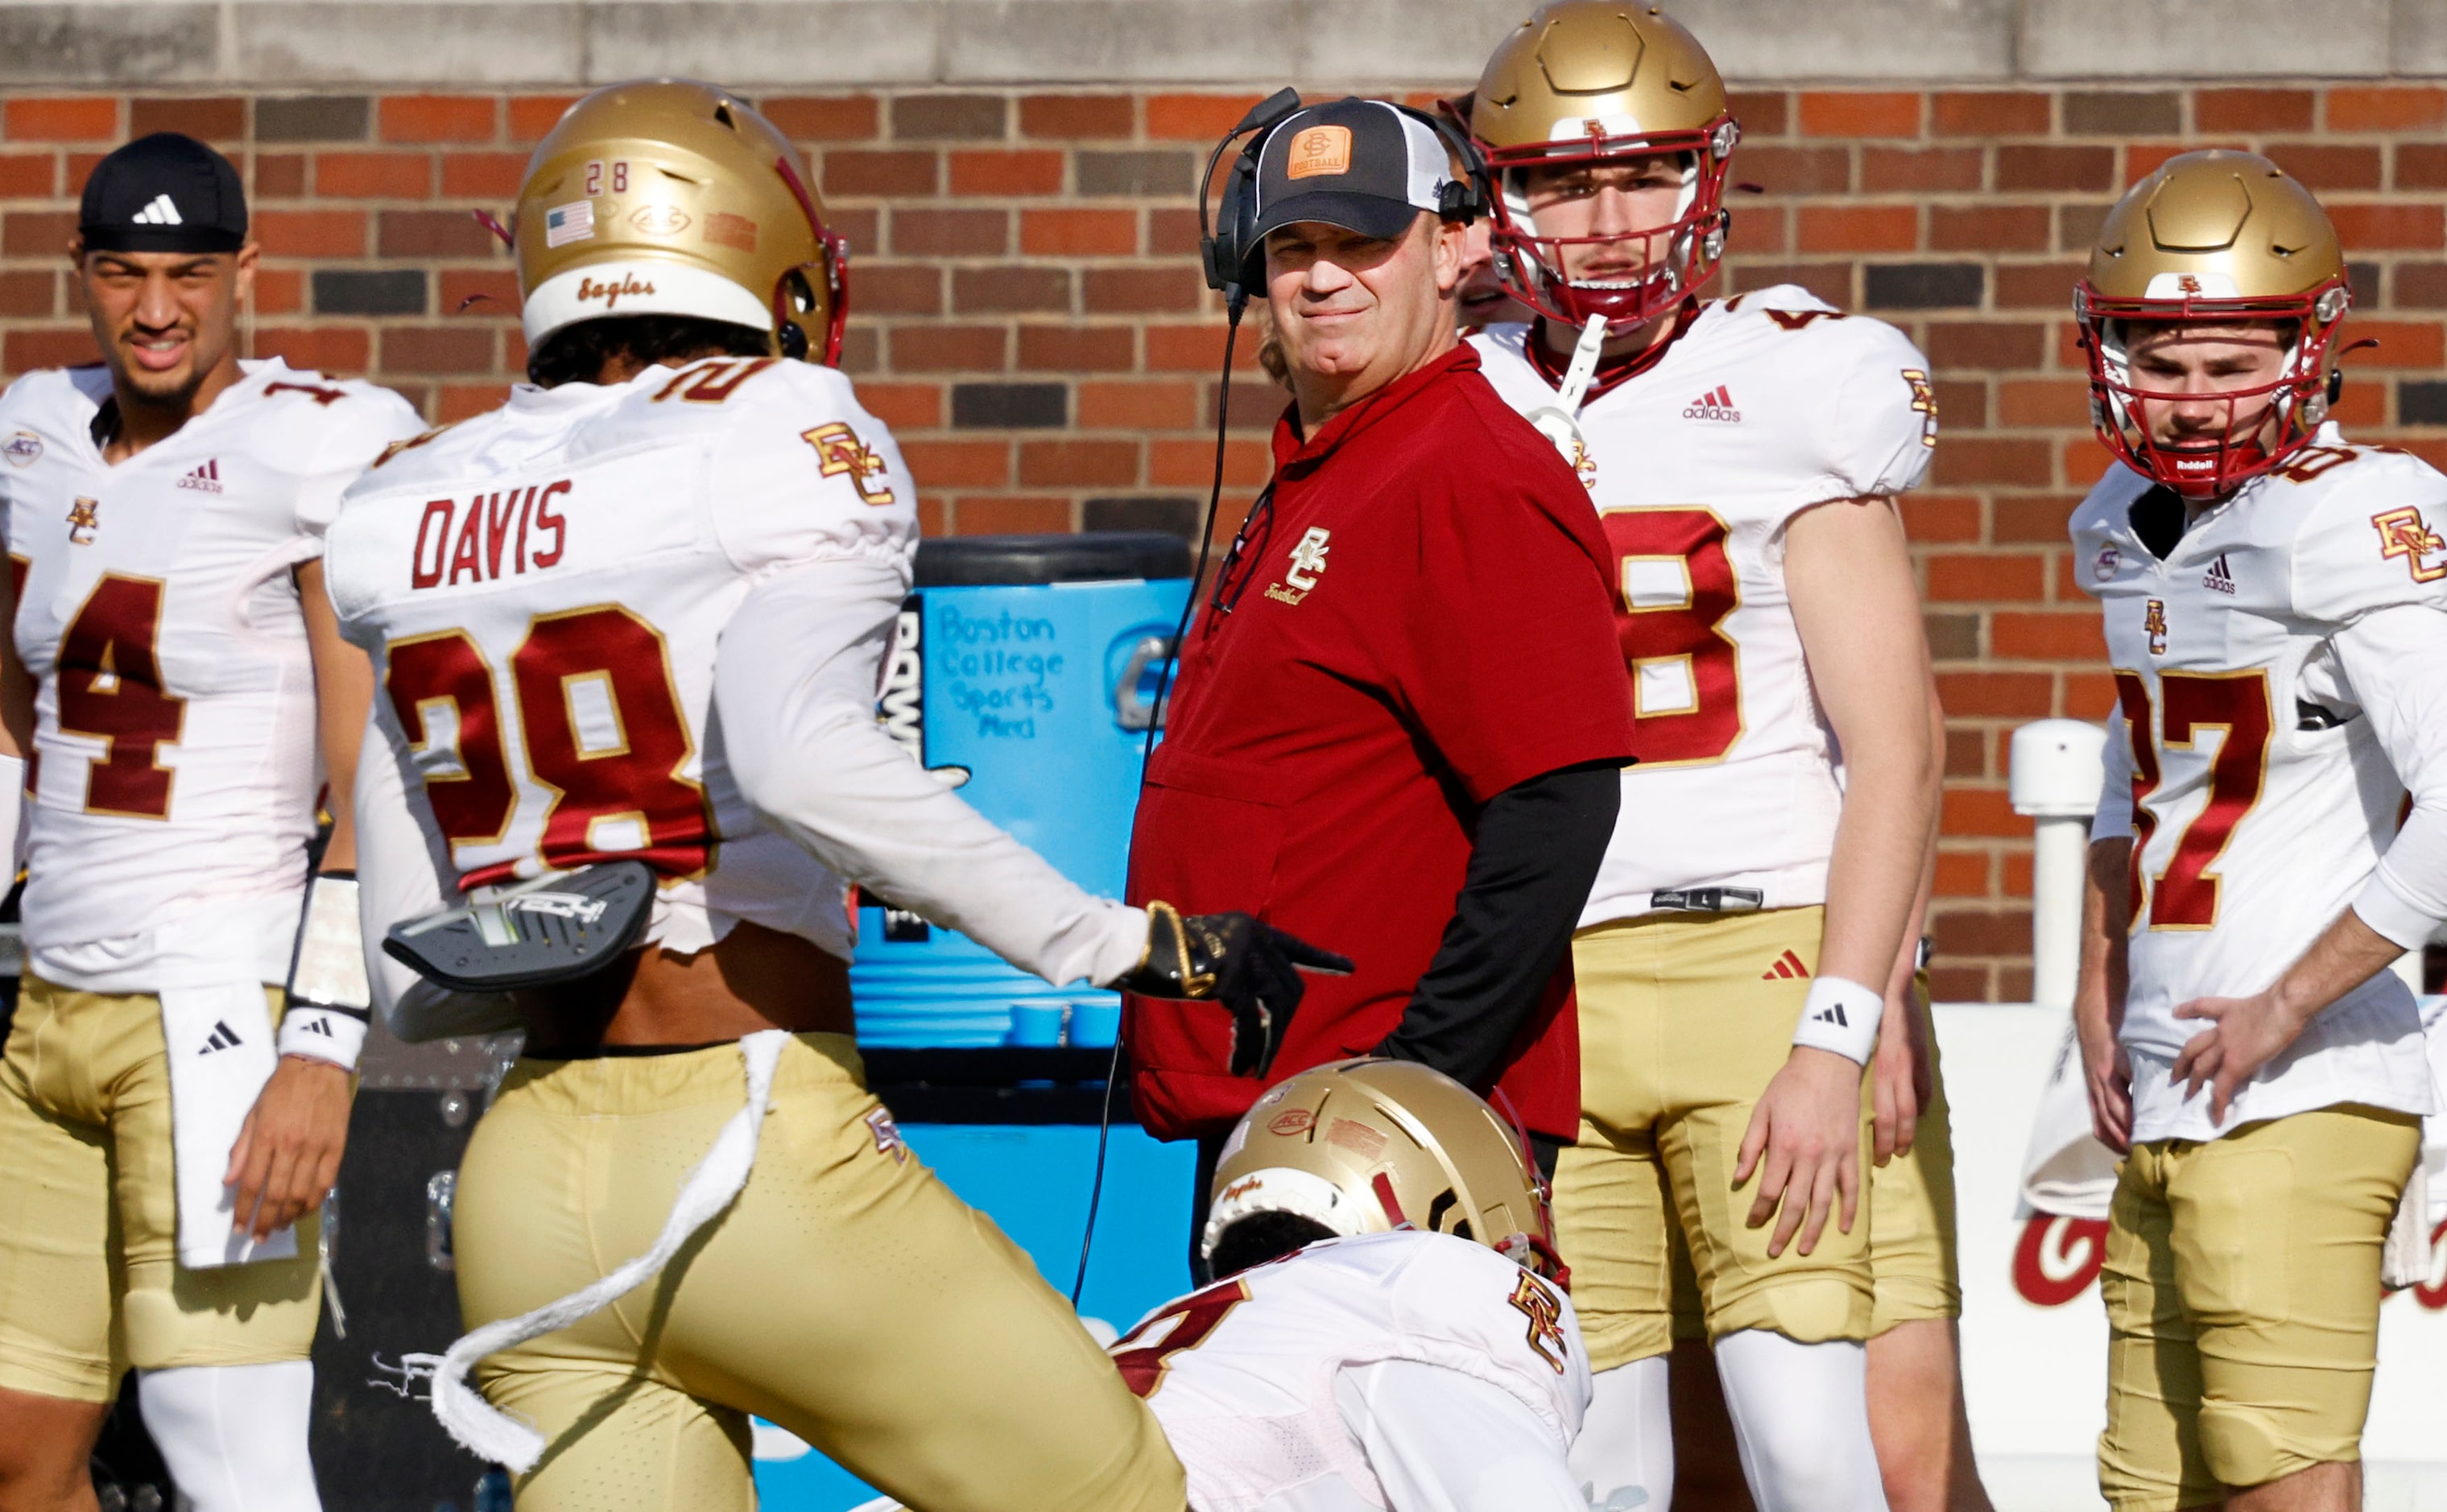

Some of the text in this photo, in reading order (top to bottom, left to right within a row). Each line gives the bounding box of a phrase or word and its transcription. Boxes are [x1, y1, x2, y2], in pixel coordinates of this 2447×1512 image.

[1294, 158, 1341, 172] FOOTBALL
[586, 162, 628, 196] 28
[577, 272, 655, 308] Eagles
[1683, 405, 1741, 423] adidas
[2176, 460, 2213, 470] Riddell
[177, 477, 223, 495] adidas
[411, 479, 572, 589] DAVIS
[2203, 575, 2236, 595] adidas
[940, 605, 1056, 644] Boston
[940, 647, 1064, 687] College
[948, 681, 1054, 716] Sports
[978, 714, 1035, 739] Med
[1277, 1114, 1308, 1128] ACC
